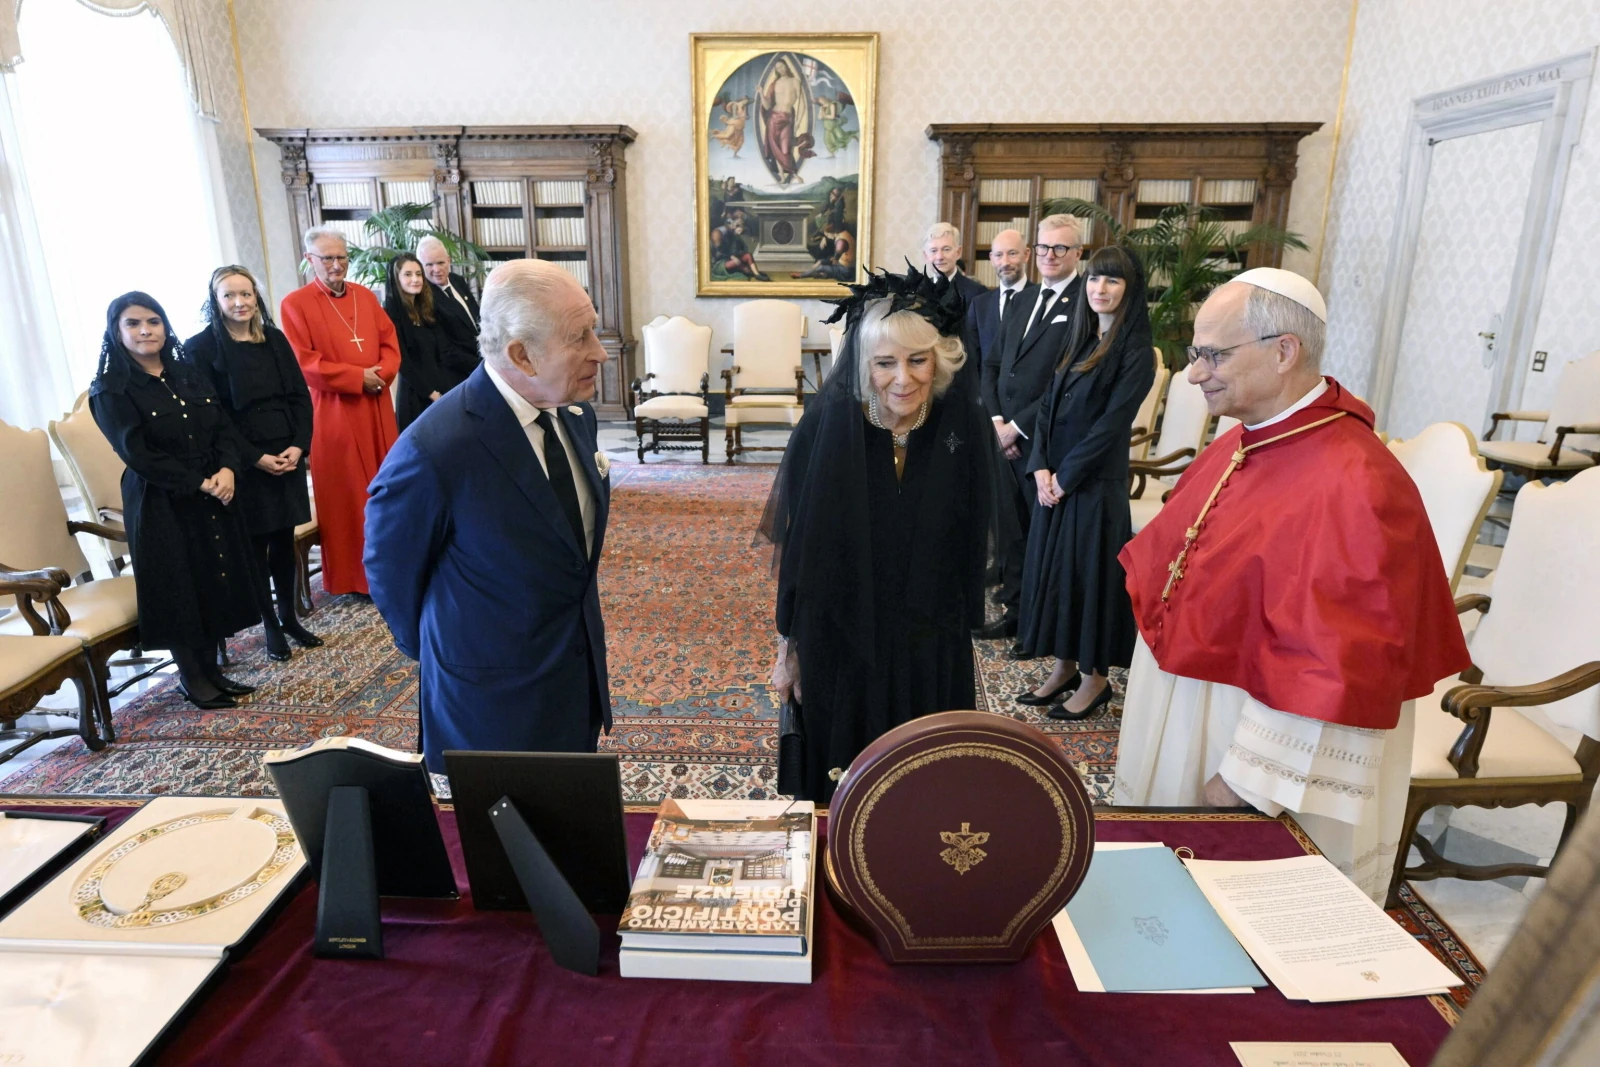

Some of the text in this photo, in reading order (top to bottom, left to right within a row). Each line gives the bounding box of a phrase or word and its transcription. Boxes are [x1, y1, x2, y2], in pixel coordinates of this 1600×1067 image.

[1503, 74, 1532, 93] PONT
[1537, 67, 1561, 84] MAX
[675, 884, 801, 900] UDIENZE
[741, 898, 801, 909] DELLE
[632, 904, 801, 922] PONTIFICIO
[628, 918, 800, 931] L'APPARTAMENTO
